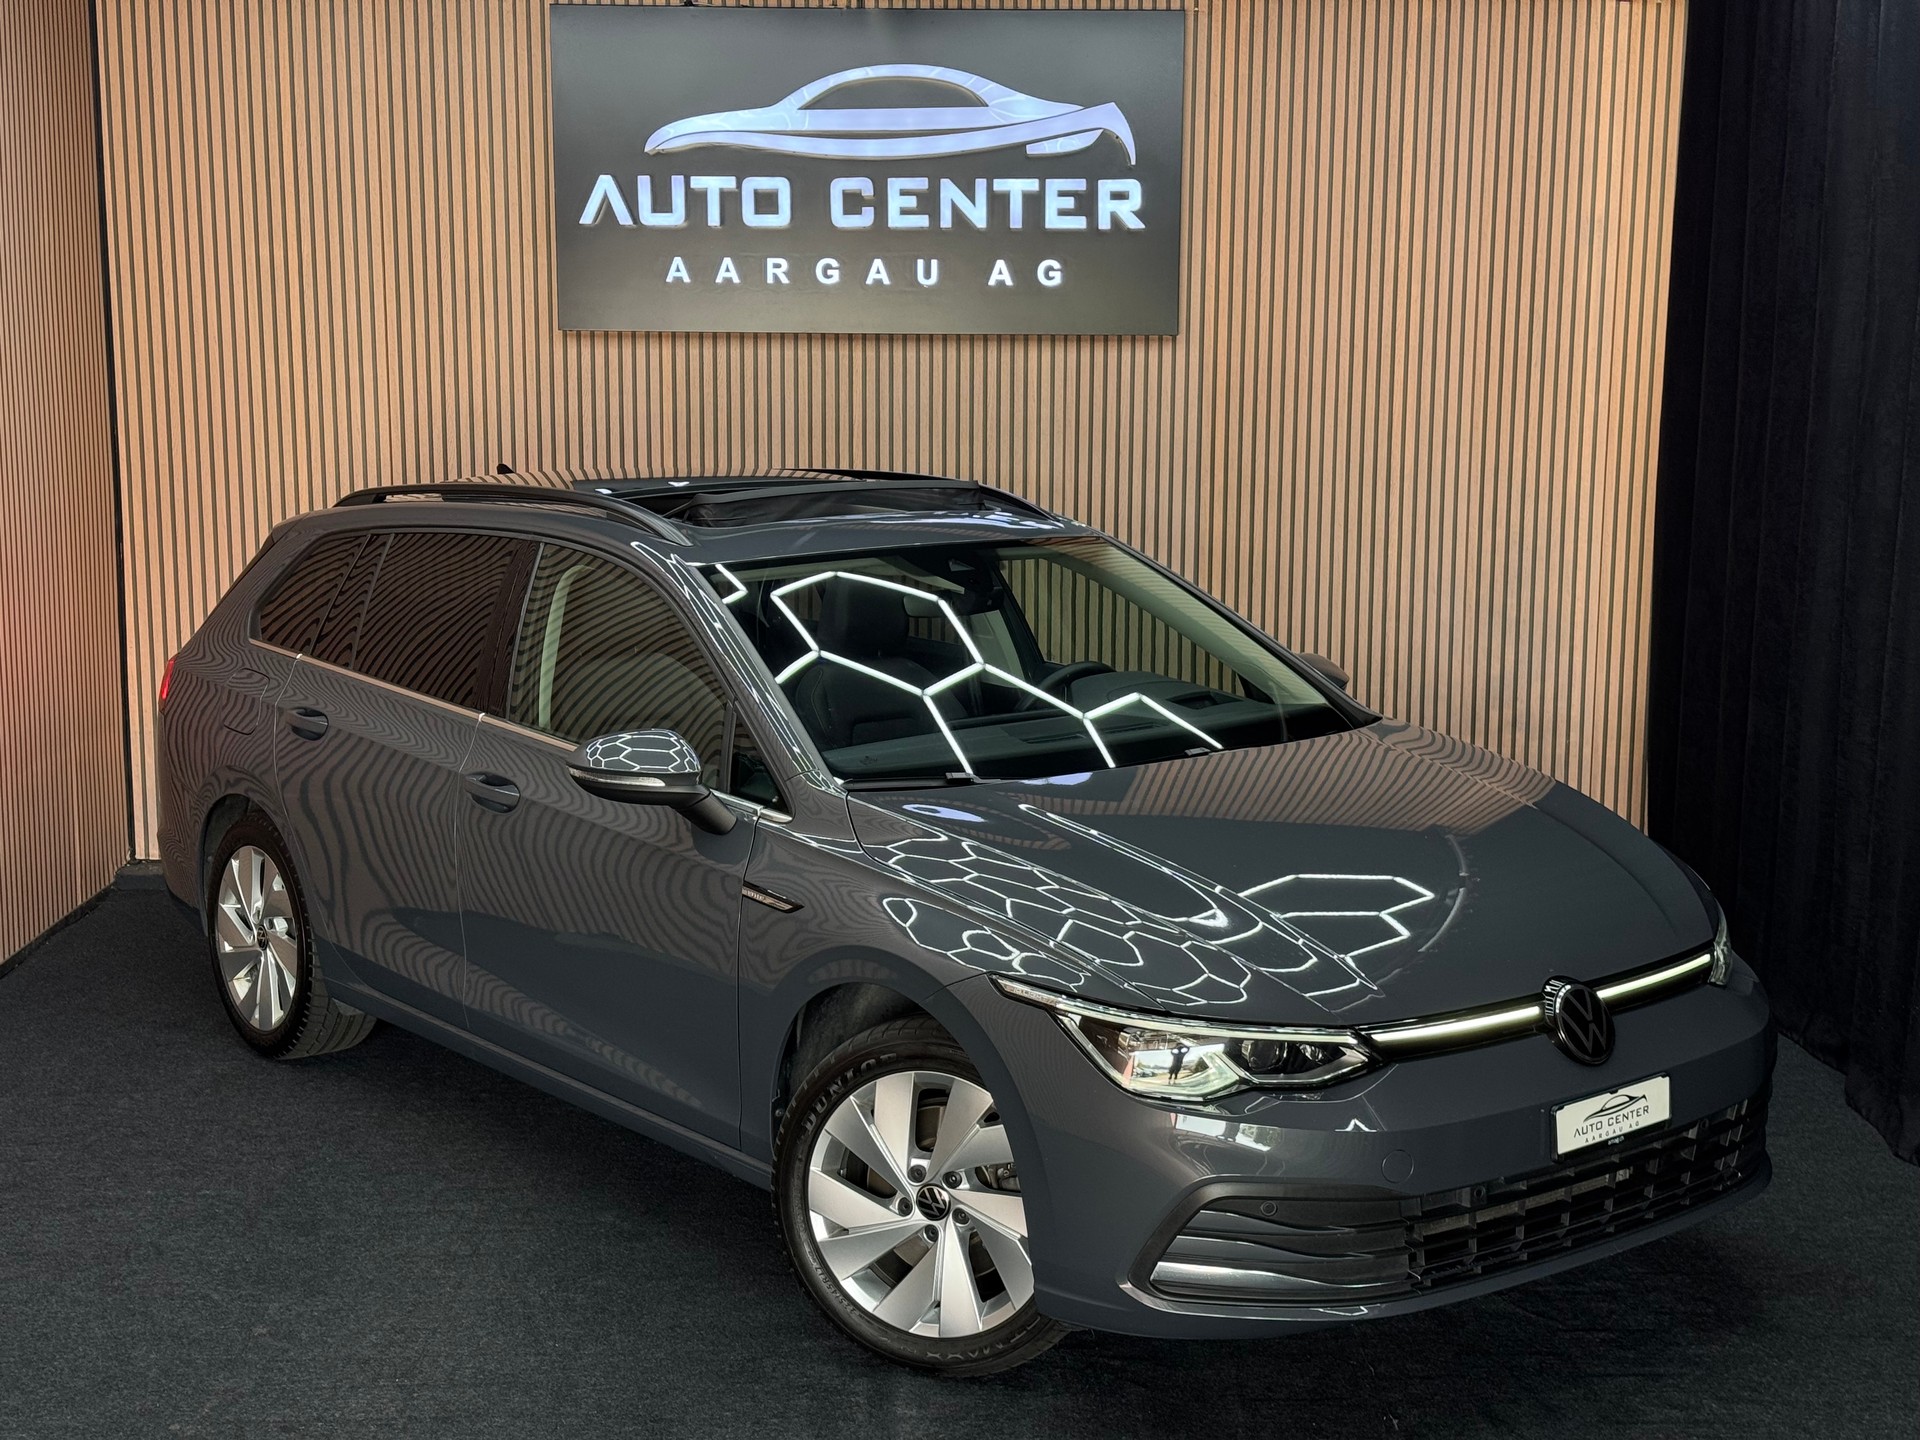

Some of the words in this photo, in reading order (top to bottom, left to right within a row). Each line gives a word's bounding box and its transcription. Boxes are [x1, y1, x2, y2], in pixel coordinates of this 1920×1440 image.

[579, 174, 791, 228] AUTO
[830, 175, 1146, 230] CENTER
[665, 256, 940, 289] AARGAU
[986, 258, 1063, 288] AG
[802, 1053, 897, 1133] DUNLOP
[1573, 1120, 1603, 1138] AUTO
[1607, 1105, 1650, 1127] CENTER
[1584, 1126, 1623, 1143] AARGAU
